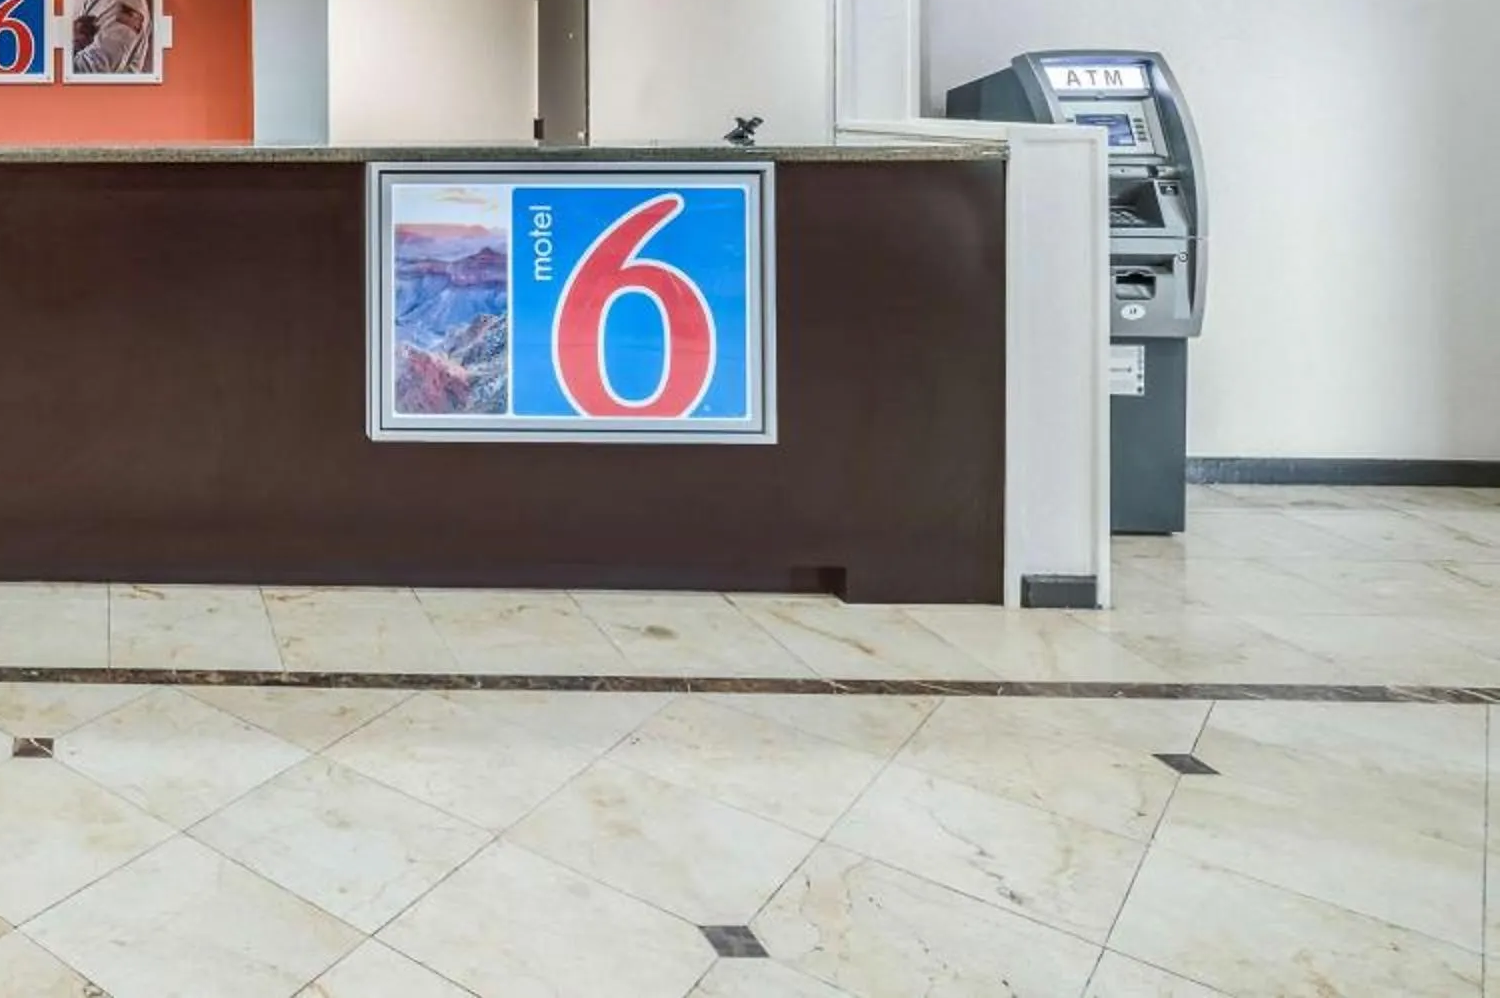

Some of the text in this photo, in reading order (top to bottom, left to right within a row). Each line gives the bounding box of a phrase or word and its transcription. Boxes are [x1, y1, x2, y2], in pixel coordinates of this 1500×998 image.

[1067, 69, 1123, 86] ATM
[529, 192, 716, 417] motel 6
